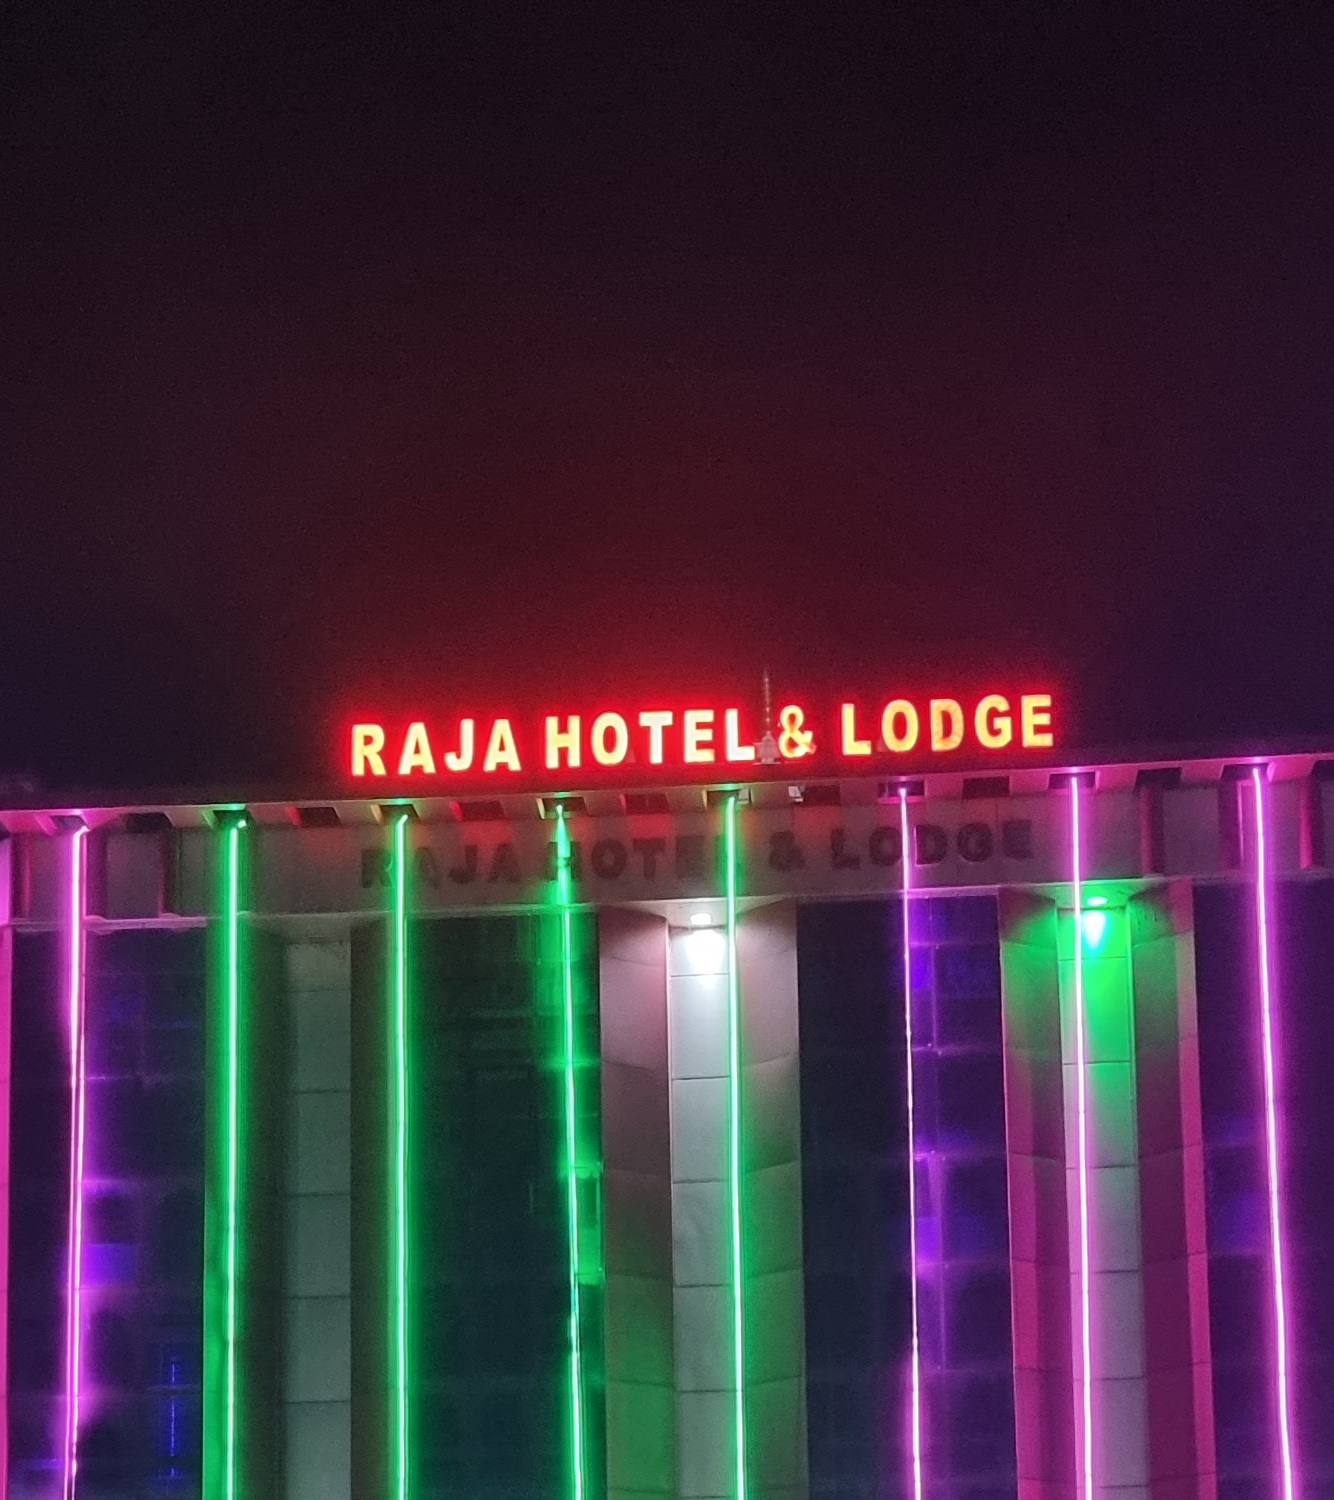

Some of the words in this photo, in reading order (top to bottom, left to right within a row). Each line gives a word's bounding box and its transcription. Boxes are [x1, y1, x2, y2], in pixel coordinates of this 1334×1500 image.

[352, 718, 522, 776] RAJA
[545, 708, 755, 769] HOTEL
[779, 704, 816, 759] &
[842, 694, 1054, 756] LODGE
